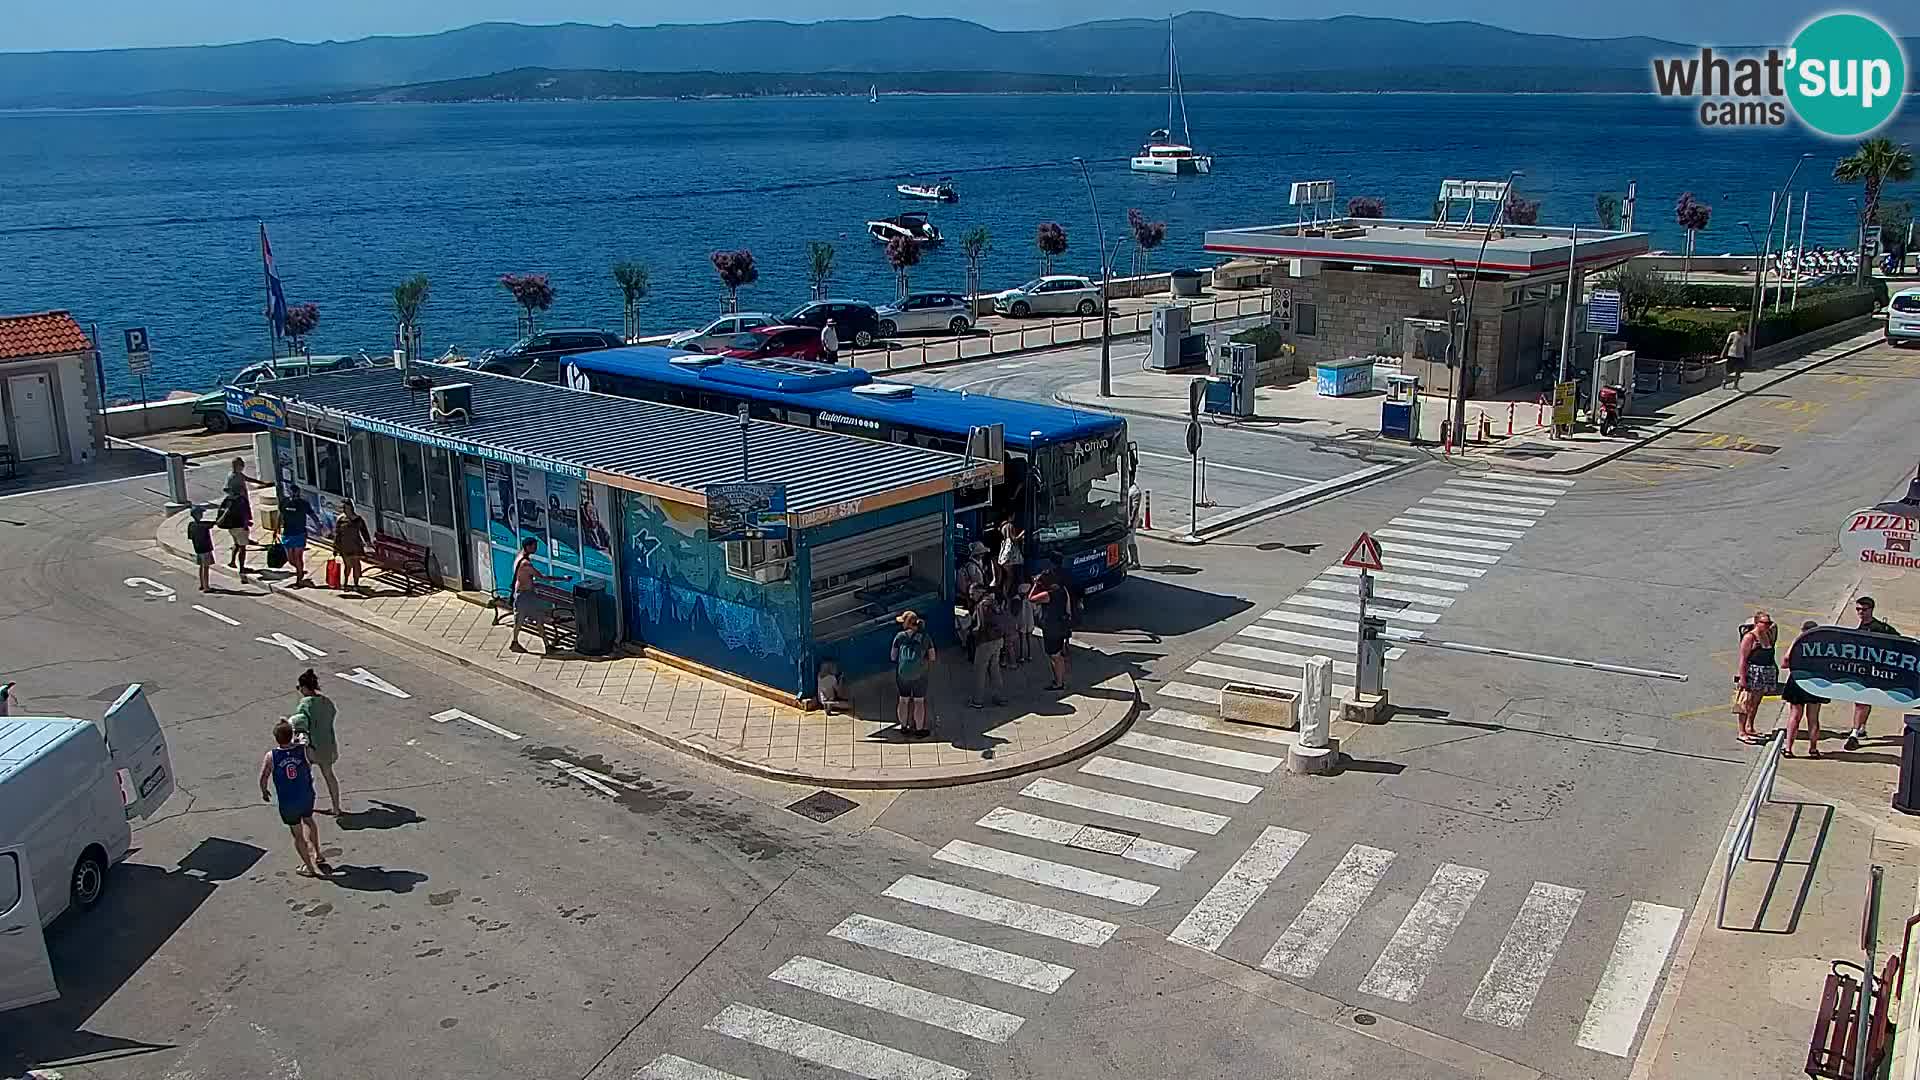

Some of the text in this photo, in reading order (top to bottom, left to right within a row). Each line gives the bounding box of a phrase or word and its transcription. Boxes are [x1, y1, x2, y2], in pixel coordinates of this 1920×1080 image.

[130, 331, 142, 349] P
[396, 427, 436, 445] AUTOBUSNA
[436, 438, 468, 452] POSTAJA
[478, 447, 493, 458] BUS
[493, 450, 526, 465] STATION
[529, 457, 554, 471] TICKET
[555, 461, 582, 477] OFFICE
[1847, 515, 1920, 533] PIZZE
[1801, 642, 1920, 673] MARINER
[1829, 661, 1899, 680] caffe bar
[286, 763, 298, 780] 6
